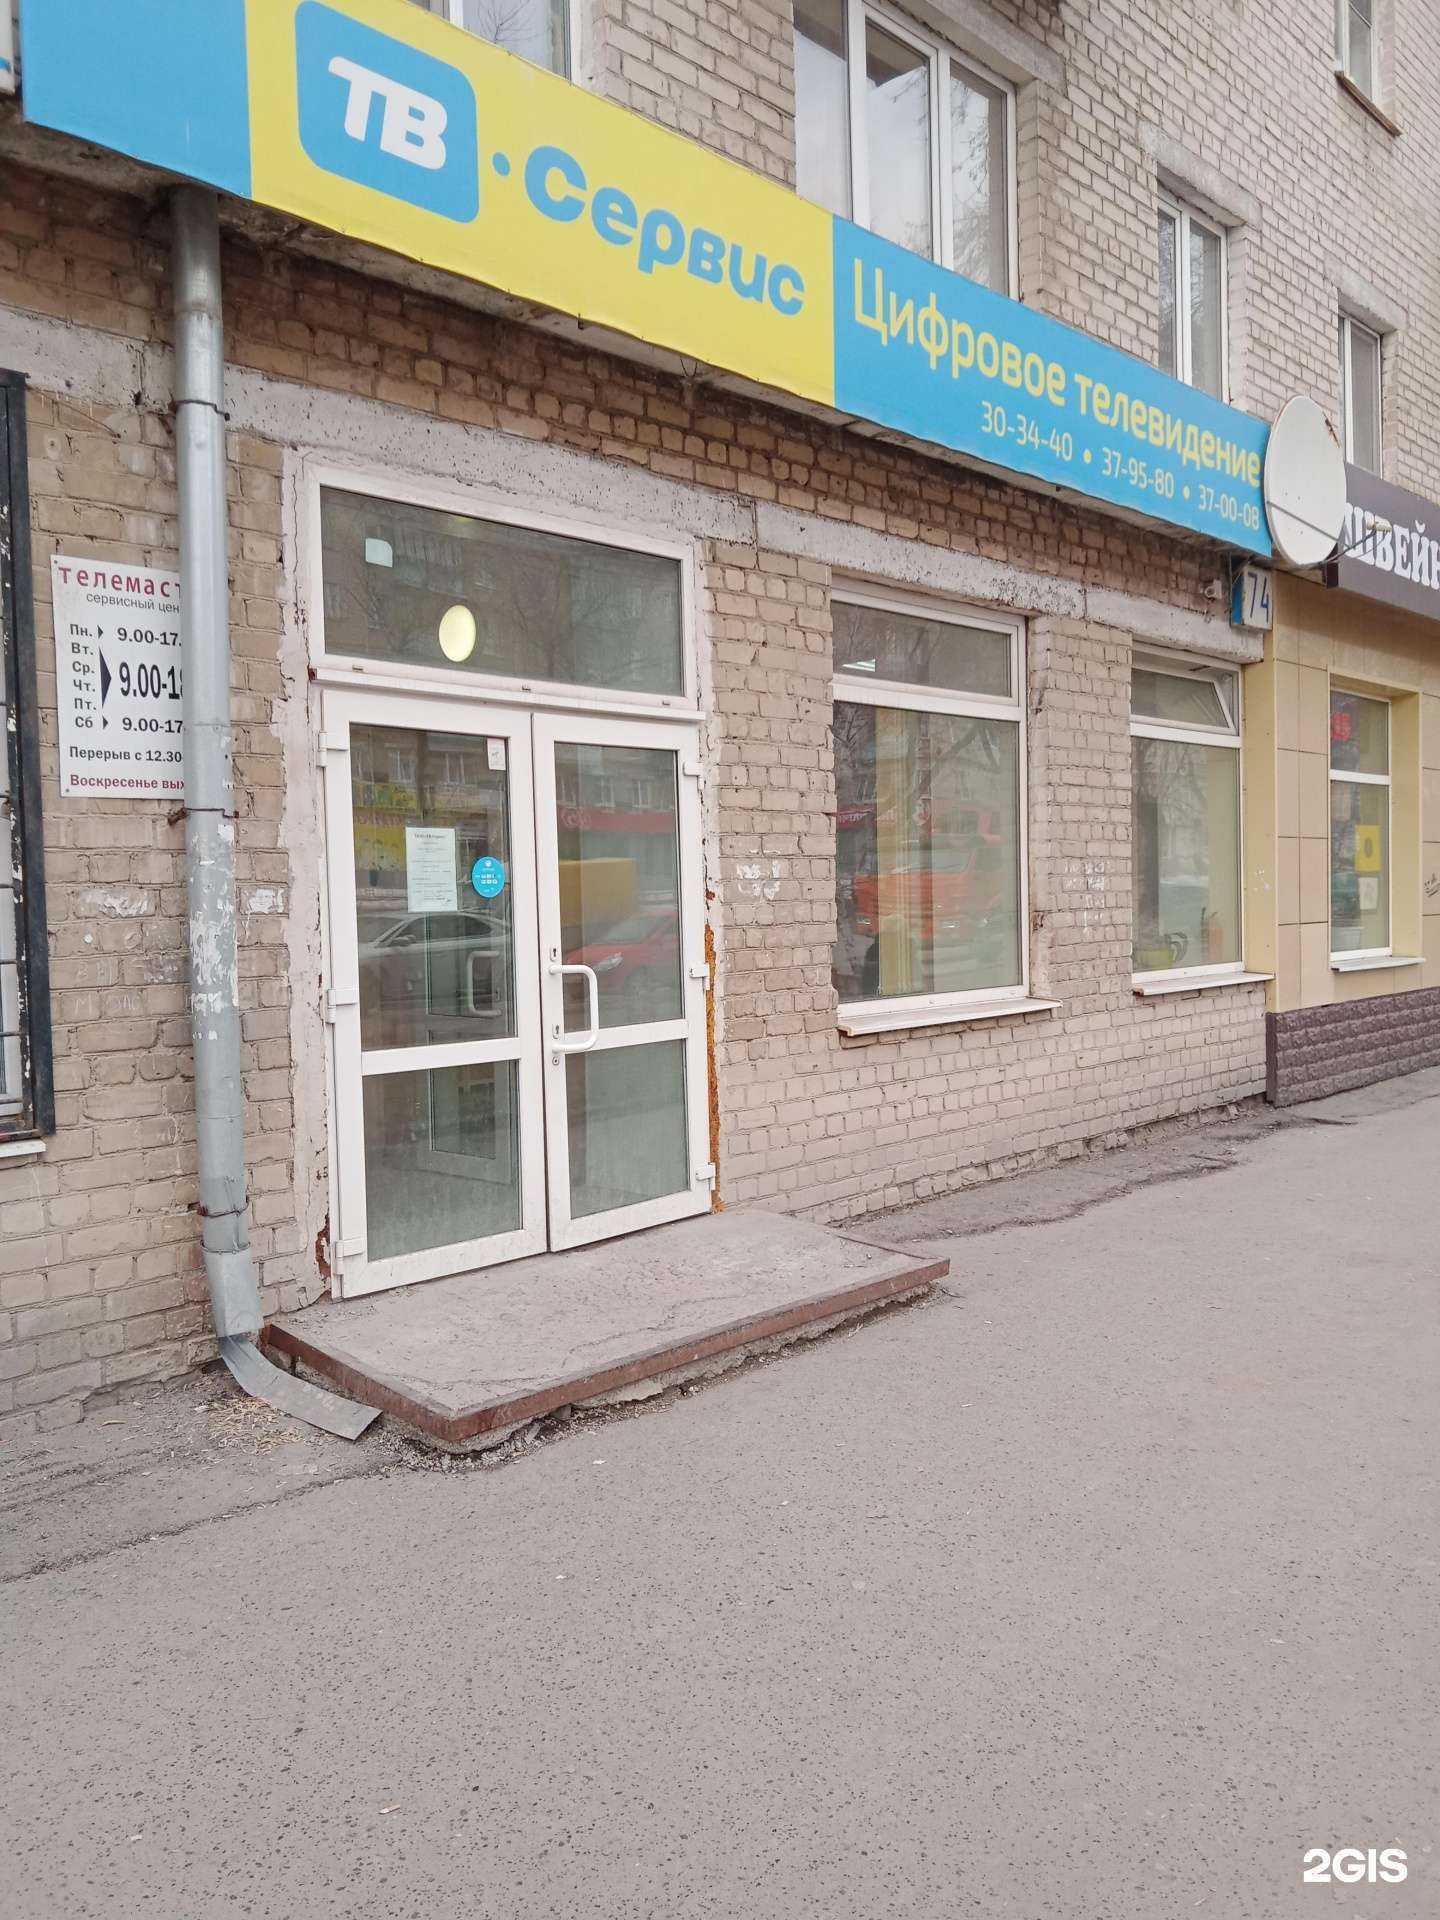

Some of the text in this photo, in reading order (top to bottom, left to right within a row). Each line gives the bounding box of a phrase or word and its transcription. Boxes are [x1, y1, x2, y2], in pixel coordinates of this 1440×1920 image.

[328, 55, 805, 316] ТВ Сервис
[853, 257, 1261, 488] Цифровое телевидение
[980, 400, 1260, 531] 30-34-40 37-95-80 37-00-08
[86, 593, 155, 610] сервисный
[1247, 572, 1269, 624] 74
[70, 623, 93, 637] Пн.
[71, 642, 94, 656] Вт.
[72, 660, 95, 676] Ср.
[73, 679, 96, 692] Чт.
[119, 661, 182, 700] 9.00-1
[74, 697, 97, 711] Пт.
[75, 716, 93, 729] Сб
[69, 745, 131, 762] Перерыв
[134, 752, 142, 761] с
[70, 774, 158, 790] Воскресенье
